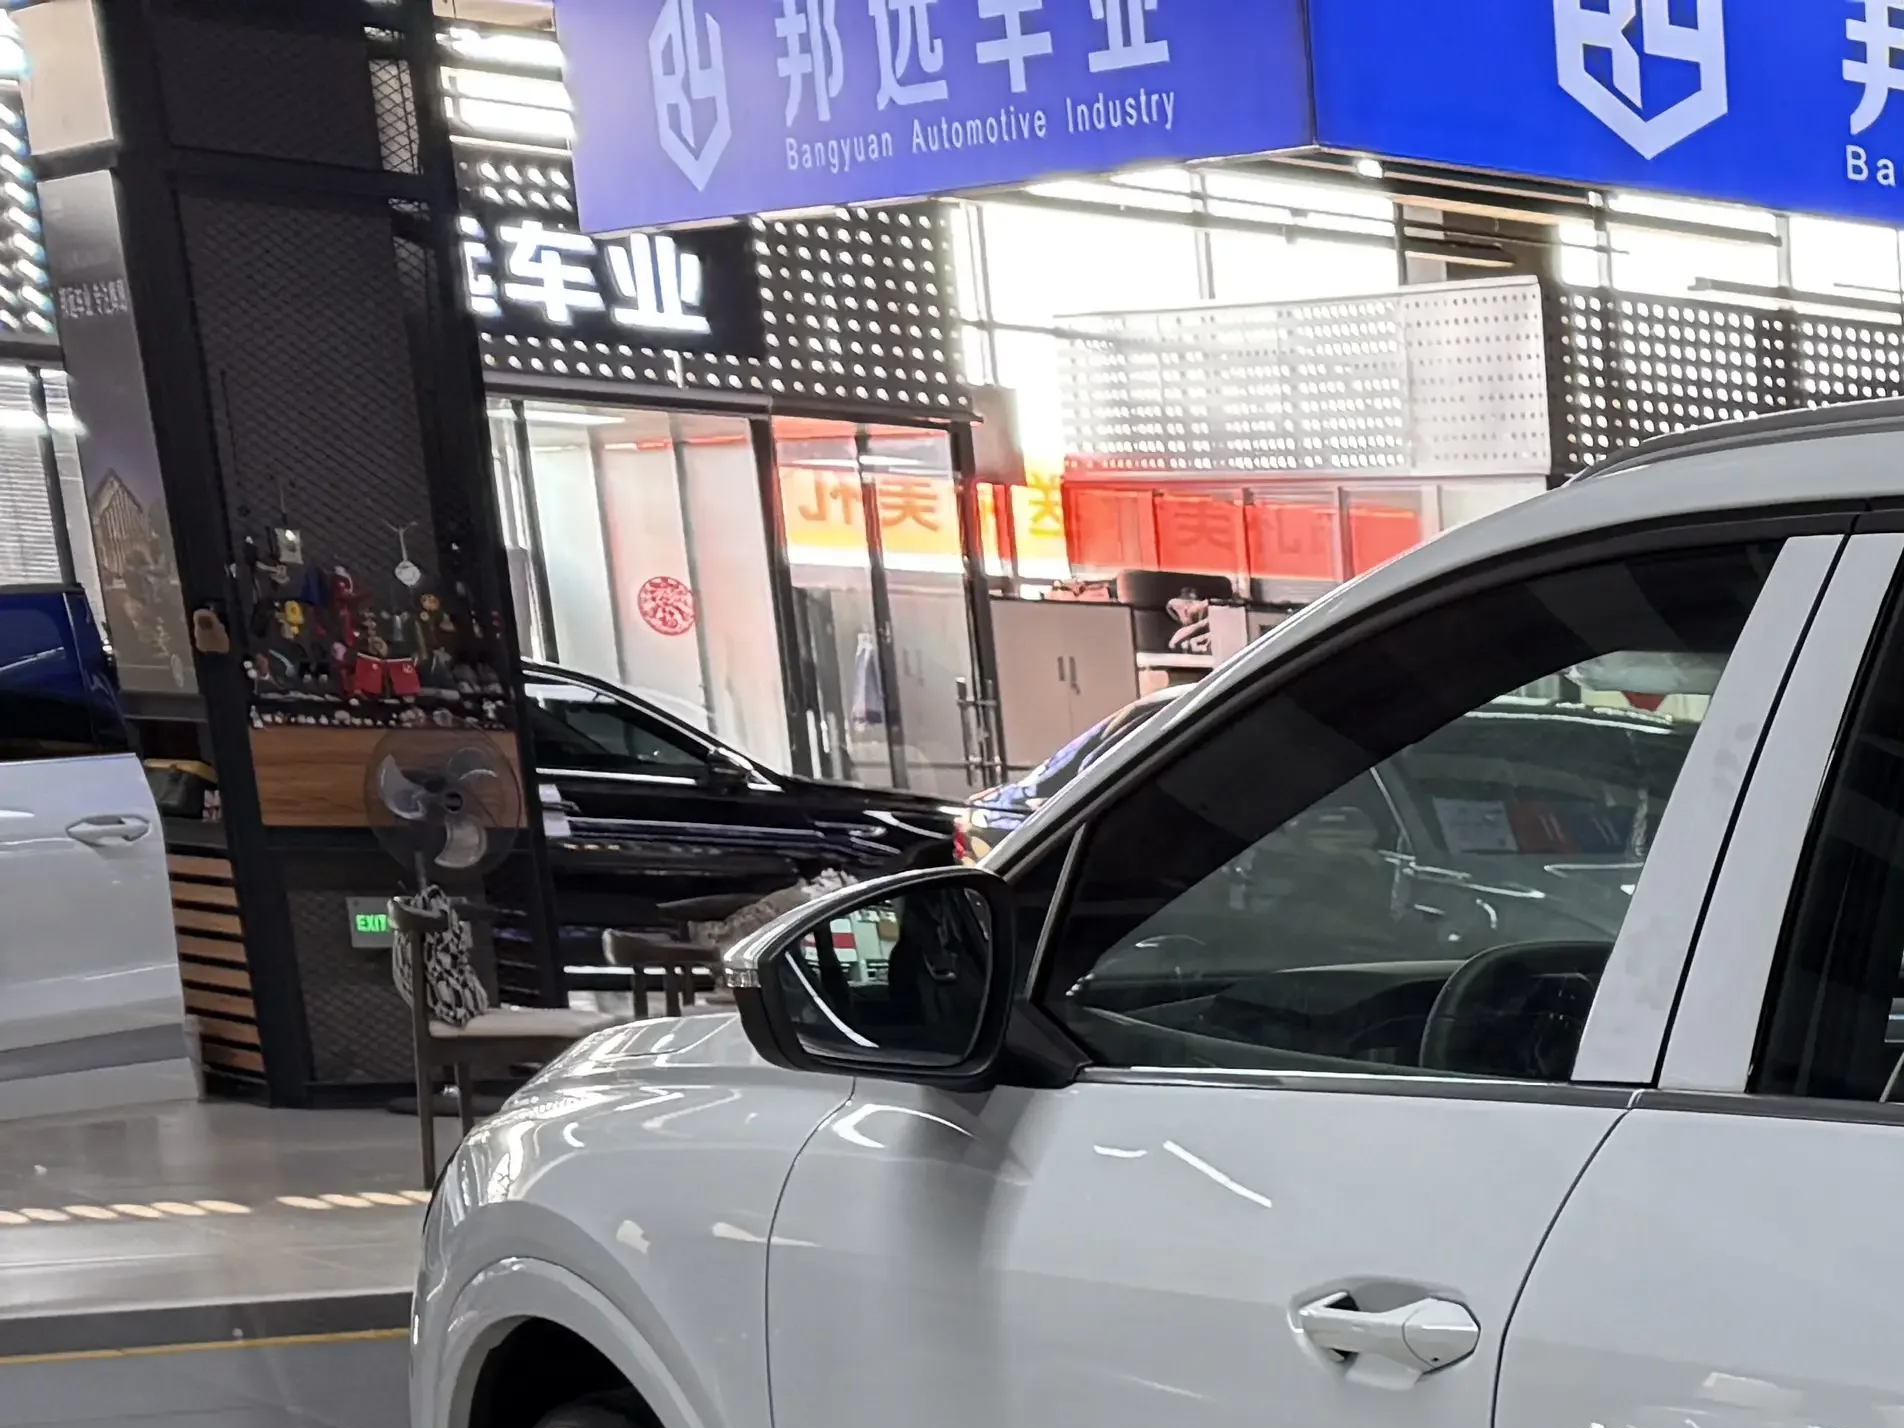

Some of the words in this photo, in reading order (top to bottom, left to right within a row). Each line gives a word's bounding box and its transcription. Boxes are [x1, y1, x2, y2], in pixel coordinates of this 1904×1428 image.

[785, 133, 894, 173] Bangyuan
[911, 106, 1047, 155] Automotive
[1066, 88, 1176, 133] Industry
[356, 913, 387, 933] EXIT
